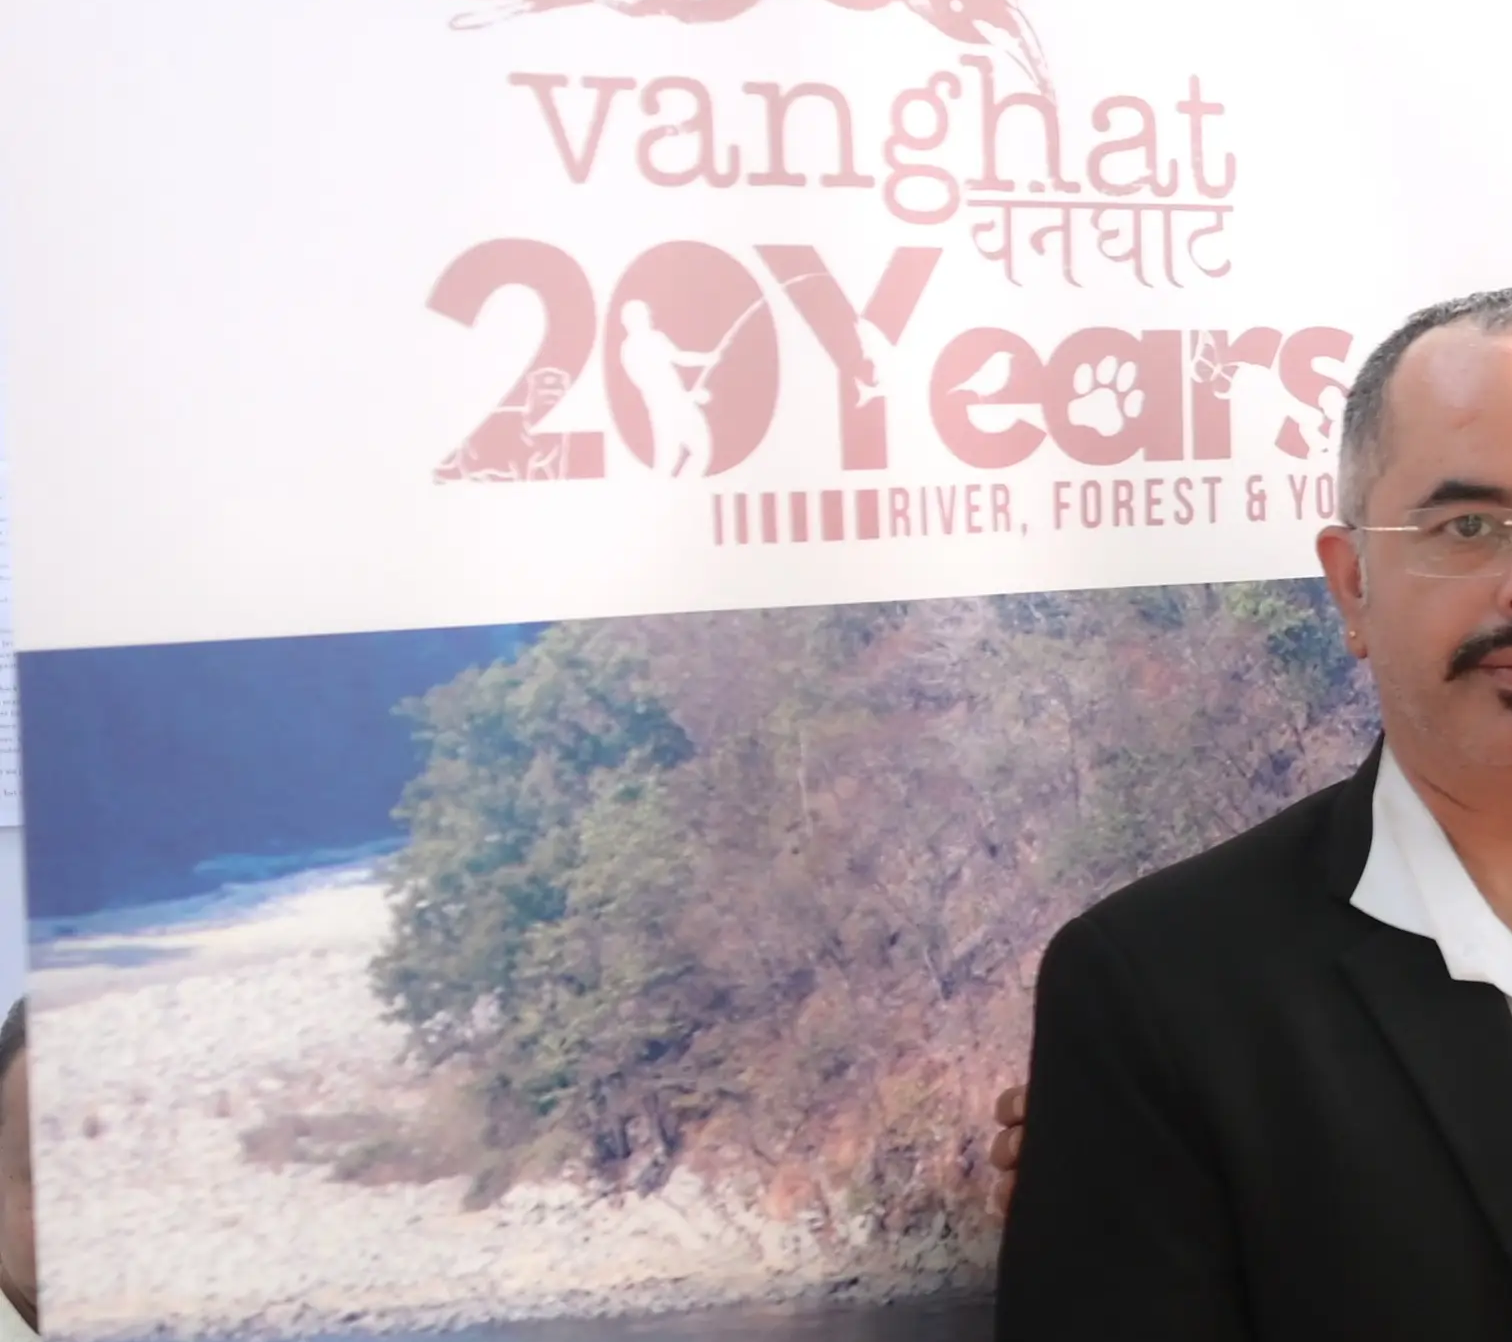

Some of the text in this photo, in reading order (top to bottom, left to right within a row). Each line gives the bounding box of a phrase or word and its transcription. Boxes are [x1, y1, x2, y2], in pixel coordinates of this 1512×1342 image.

[507, 53, 1237, 226] vanghat
[889, 472, 1336, 539] RIVER, FOREST & YO
